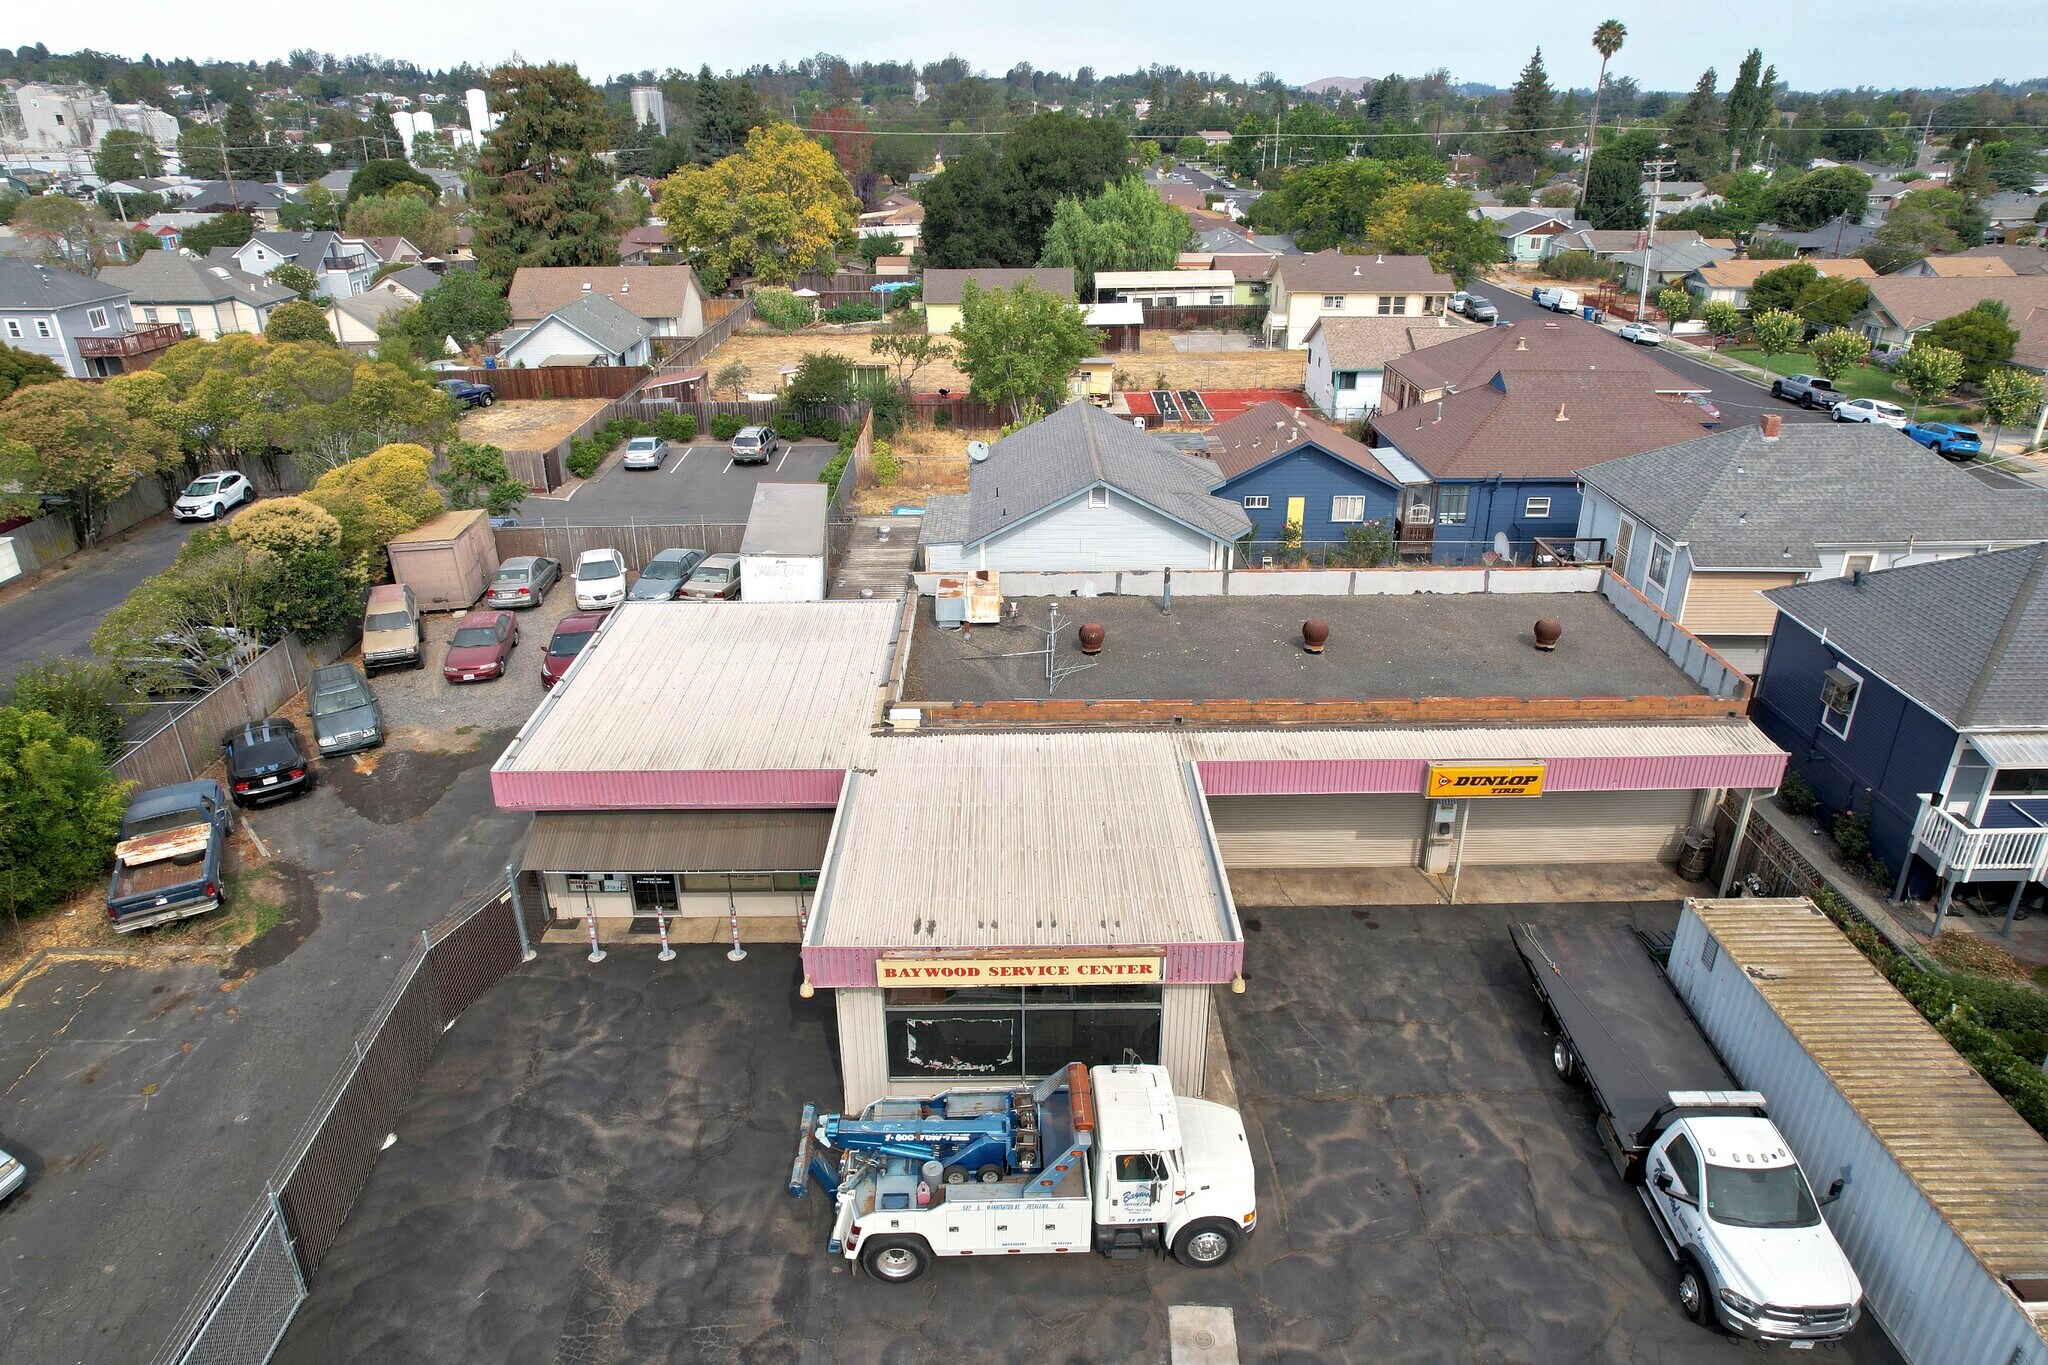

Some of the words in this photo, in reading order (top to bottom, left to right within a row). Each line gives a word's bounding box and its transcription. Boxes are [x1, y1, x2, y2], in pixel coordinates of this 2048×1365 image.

[1453, 776, 1538, 786] DUNLOP
[884, 966, 981, 978] BAYWOOD
[988, 965, 1069, 977] SERVICE
[1077, 964, 1153, 975] CENTER
[1123, 1191, 1152, 1203] Baywo
